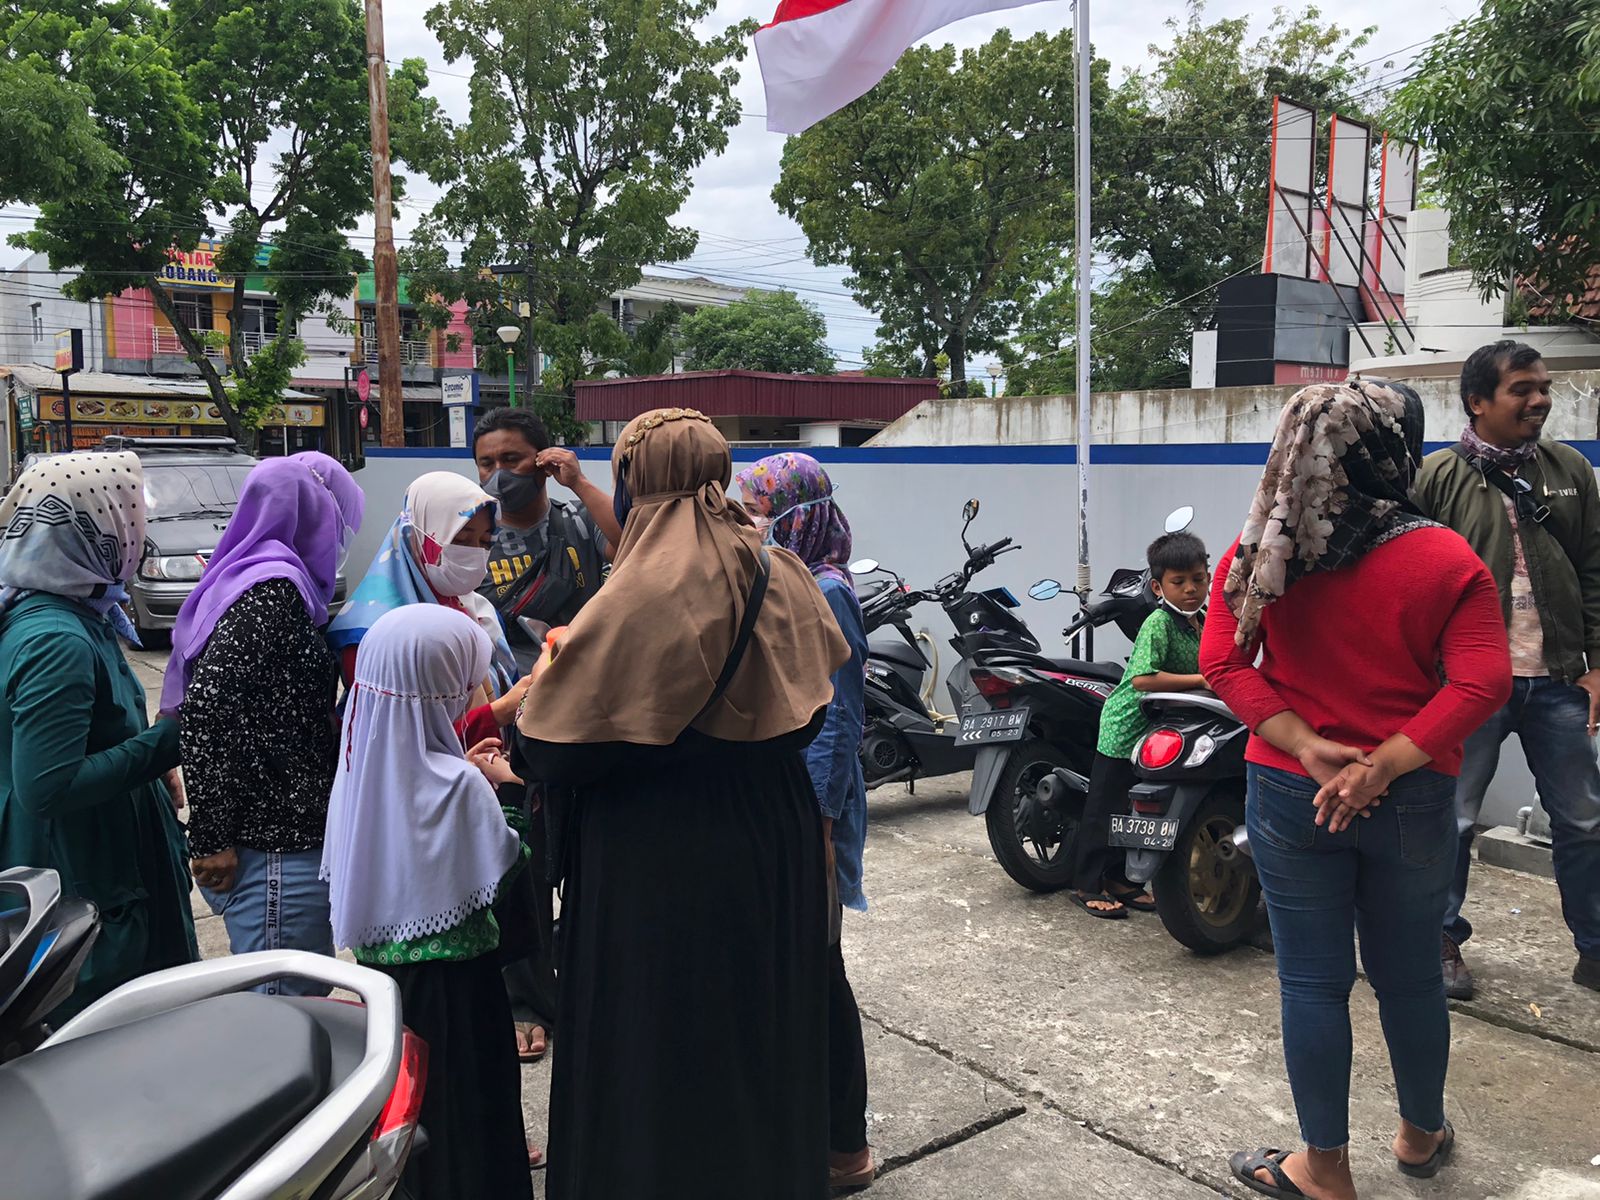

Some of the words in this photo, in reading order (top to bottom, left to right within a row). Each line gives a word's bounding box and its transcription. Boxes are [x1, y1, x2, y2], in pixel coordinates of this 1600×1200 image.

[963, 719, 975, 730] BA
[980, 716, 1005, 728] 2917
[1111, 818, 1123, 833] BA
[1126, 819, 1155, 835] 3738
[268, 879, 278, 929] OFF-WHITE
